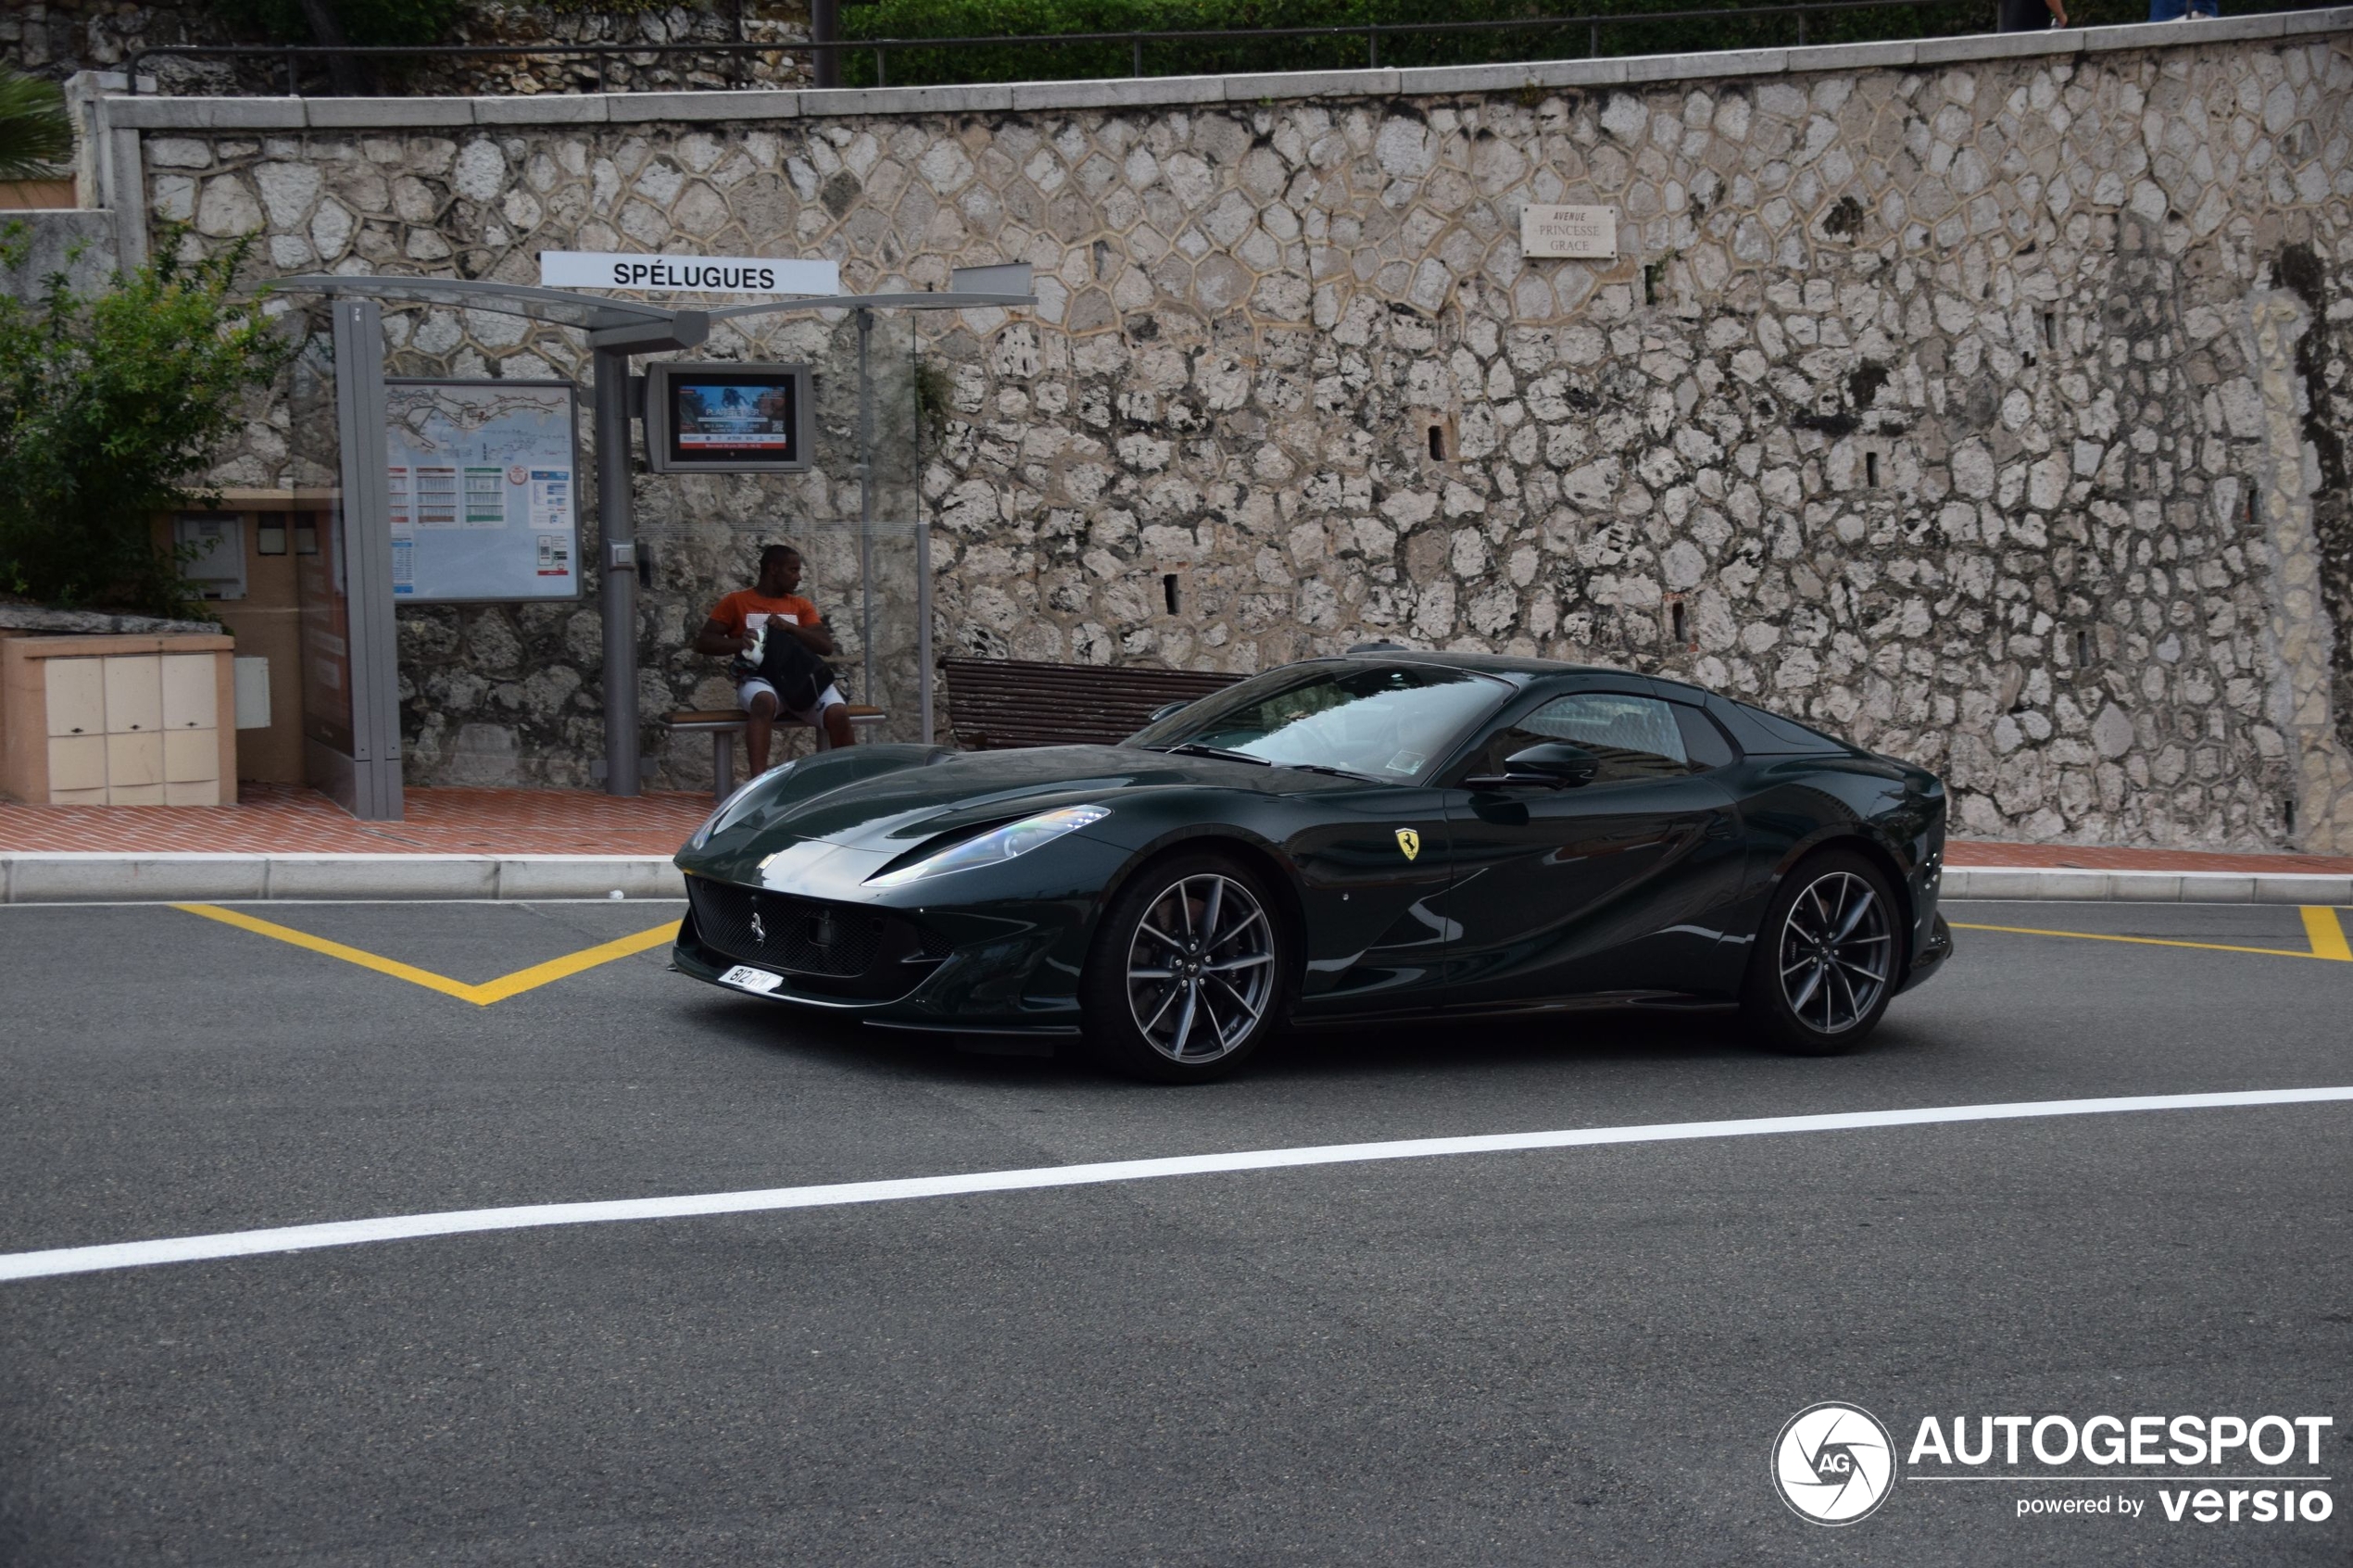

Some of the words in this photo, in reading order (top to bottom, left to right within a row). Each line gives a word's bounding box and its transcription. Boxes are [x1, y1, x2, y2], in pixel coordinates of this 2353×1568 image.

[1554, 211, 1586, 221] AVENUE
[1540, 225, 1600, 236] PRINCESSE
[1550, 240, 1590, 251] GRACE
[613, 259, 775, 290] SPÉLUGUES
[729, 969, 753, 983] 812
